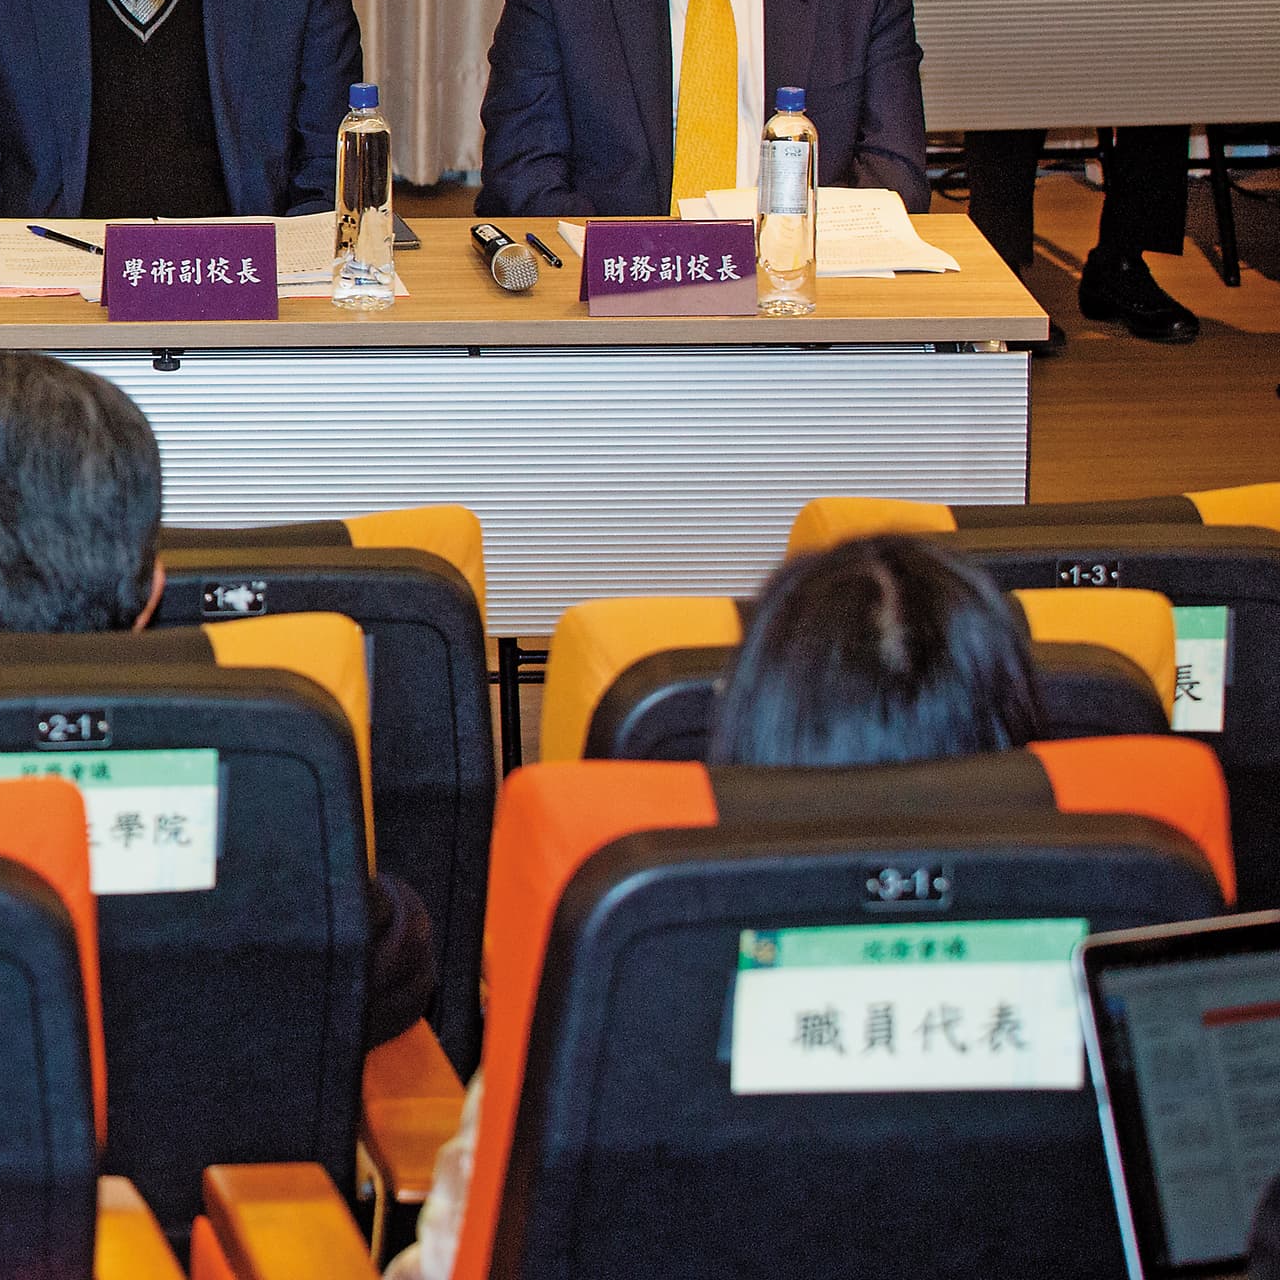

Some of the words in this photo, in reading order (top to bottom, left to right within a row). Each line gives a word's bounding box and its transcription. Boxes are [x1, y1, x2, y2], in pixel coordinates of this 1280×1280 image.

[122, 257, 262, 287] 學術副校長
[603, 254, 741, 284] 財務副校長
[1069, 564, 1107, 587] 1-3
[1174, 664, 1202, 702] 長
[47, 714, 91, 741] 2-1
[87, 811, 192, 849] 學院
[878, 868, 931, 901] 3-1
[792, 1000, 1028, 1056] 職員代表
